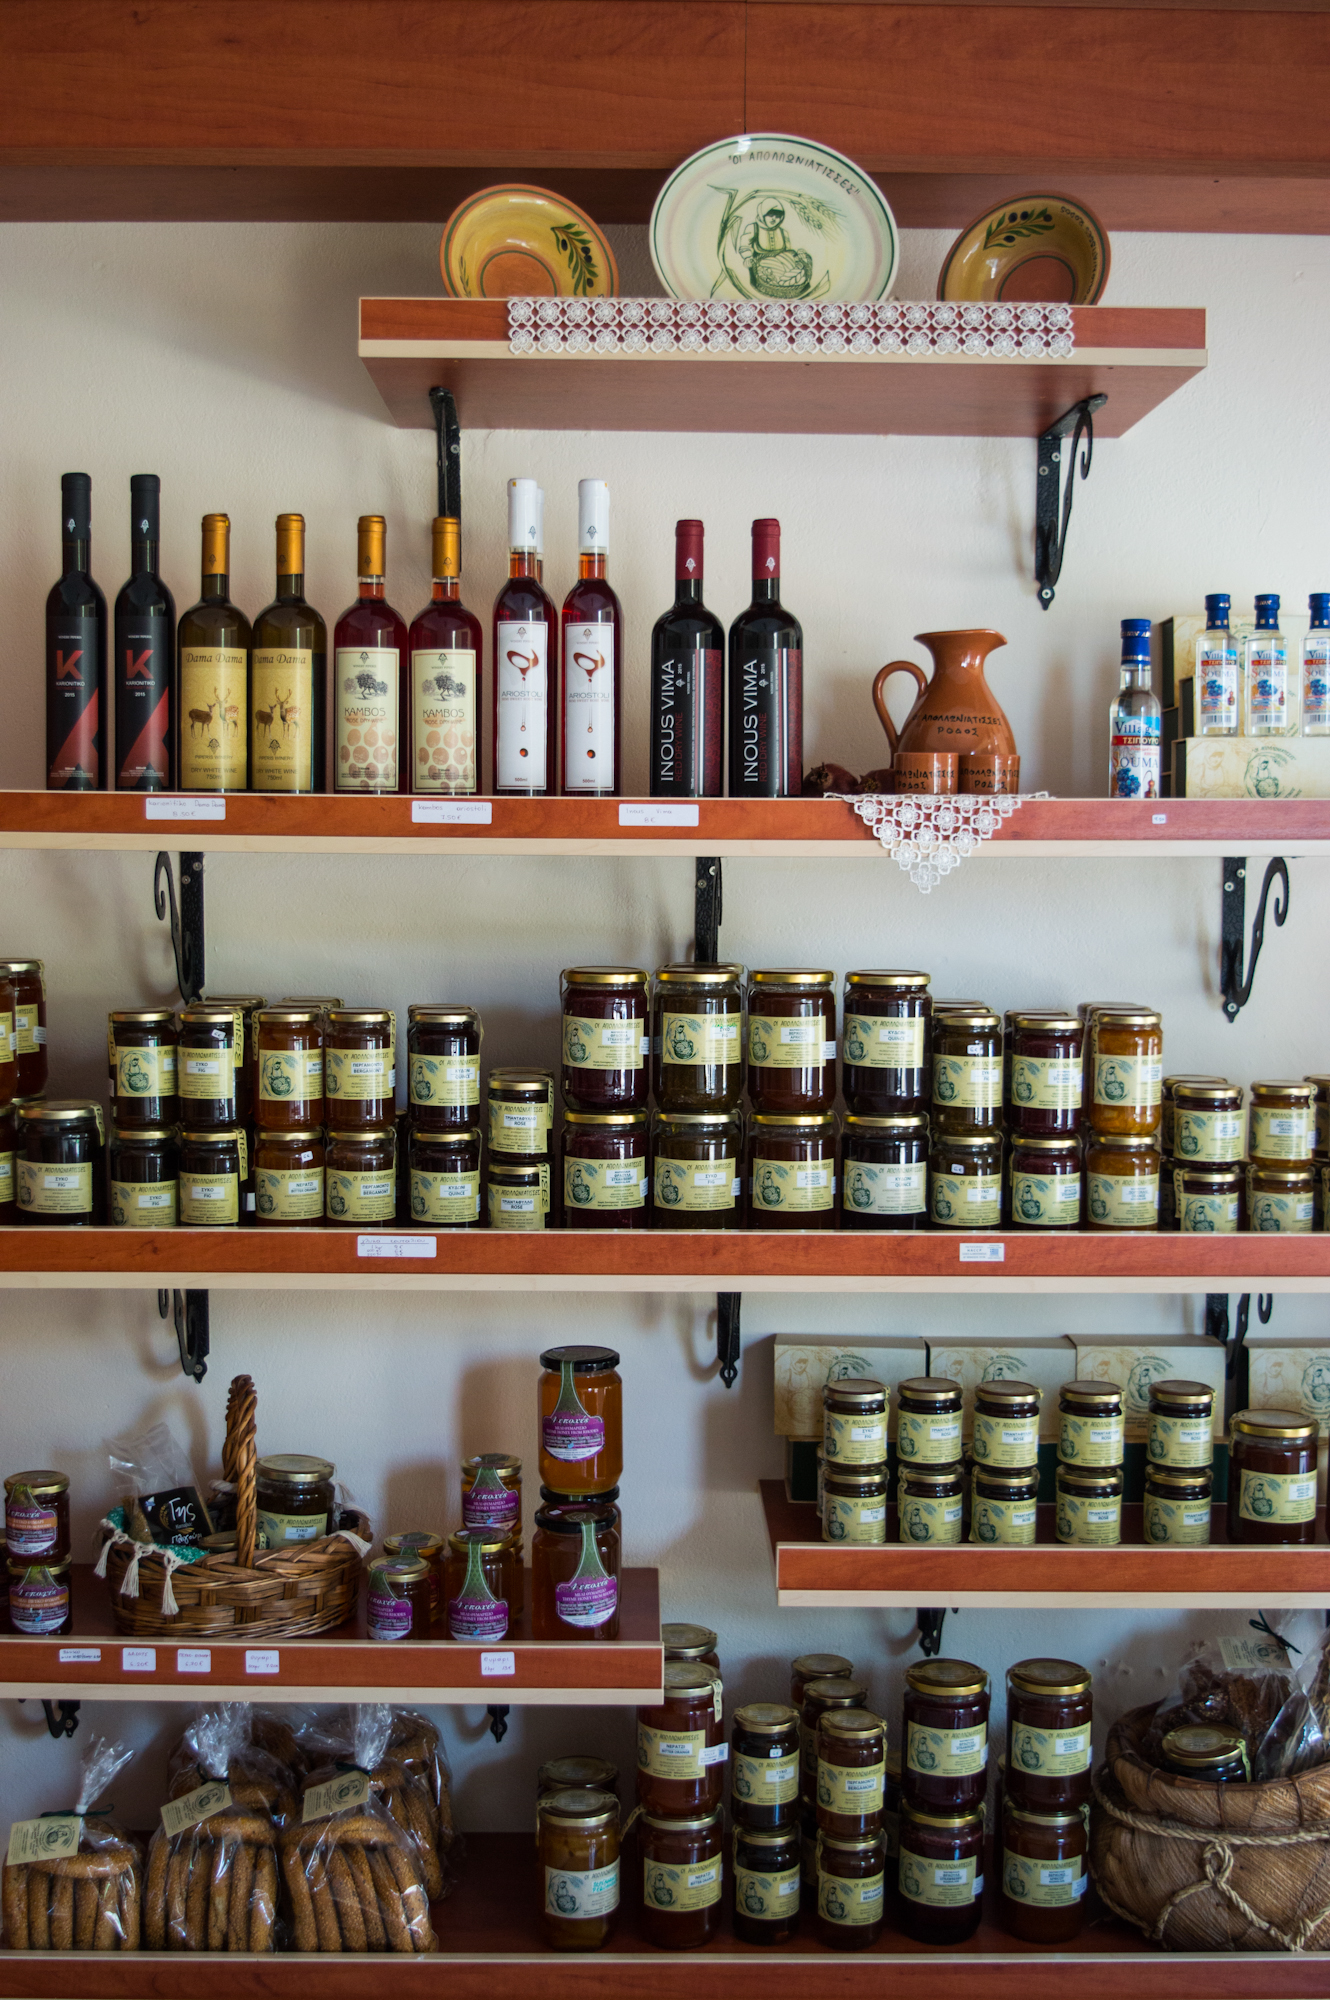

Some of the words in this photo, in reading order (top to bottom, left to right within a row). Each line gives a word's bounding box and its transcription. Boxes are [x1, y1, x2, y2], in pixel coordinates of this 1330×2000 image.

[56, 650, 84, 680] K
[126, 650, 154, 679] K
[186, 652, 212, 663] Dama
[216, 653, 243, 664] Dama
[276, 654, 306, 664] Dama
[1201, 667, 1235, 678] SOUMA
[1251, 667, 1285, 678] SOUMA
[661, 659, 675, 710] VIMA
[743, 659, 758, 710] VIMA
[344, 707, 386, 717] KAMBOS
[422, 708, 465, 718] KAMBOS
[675, 712, 683, 738] WINE
[759, 712, 768, 738] WINE
[938, 726, 979, 737] ΡΟΔΟΣ
[660, 714, 674, 782] INOUS
[675, 740, 683, 760] DRY
[744, 714, 758, 782] INOUS
[759, 740, 768, 760] DRY
[1112, 750, 1159, 768] SOUMA
[675, 761, 683, 782] RED
[759, 762, 768, 782] RED
